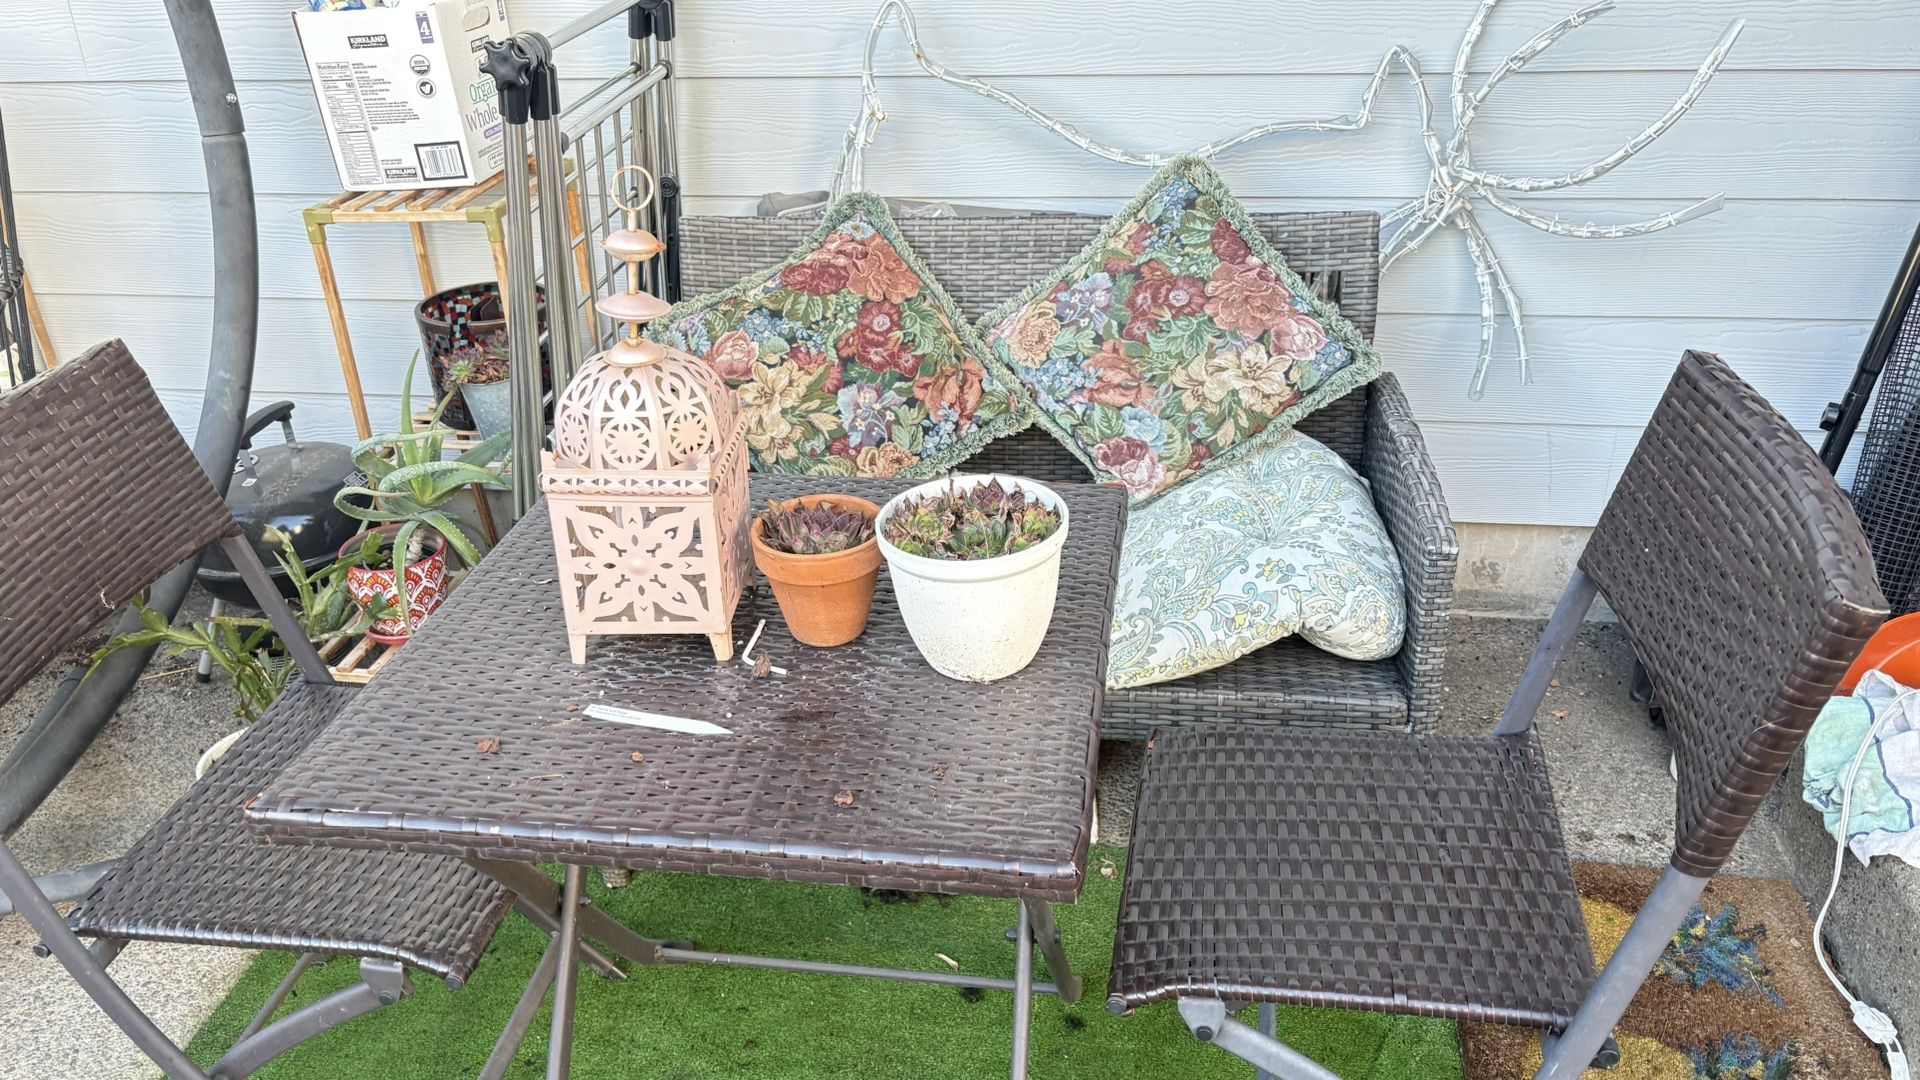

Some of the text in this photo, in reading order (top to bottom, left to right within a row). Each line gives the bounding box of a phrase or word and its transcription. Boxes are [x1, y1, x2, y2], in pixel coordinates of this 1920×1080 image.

[420, 21, 431, 36] 4
[350, 35, 386, 45] KIRKLAND
[469, 80, 496, 101] Orga
[465, 104, 499, 132] Whole
[386, 168, 416, 176] KIRKLAND
